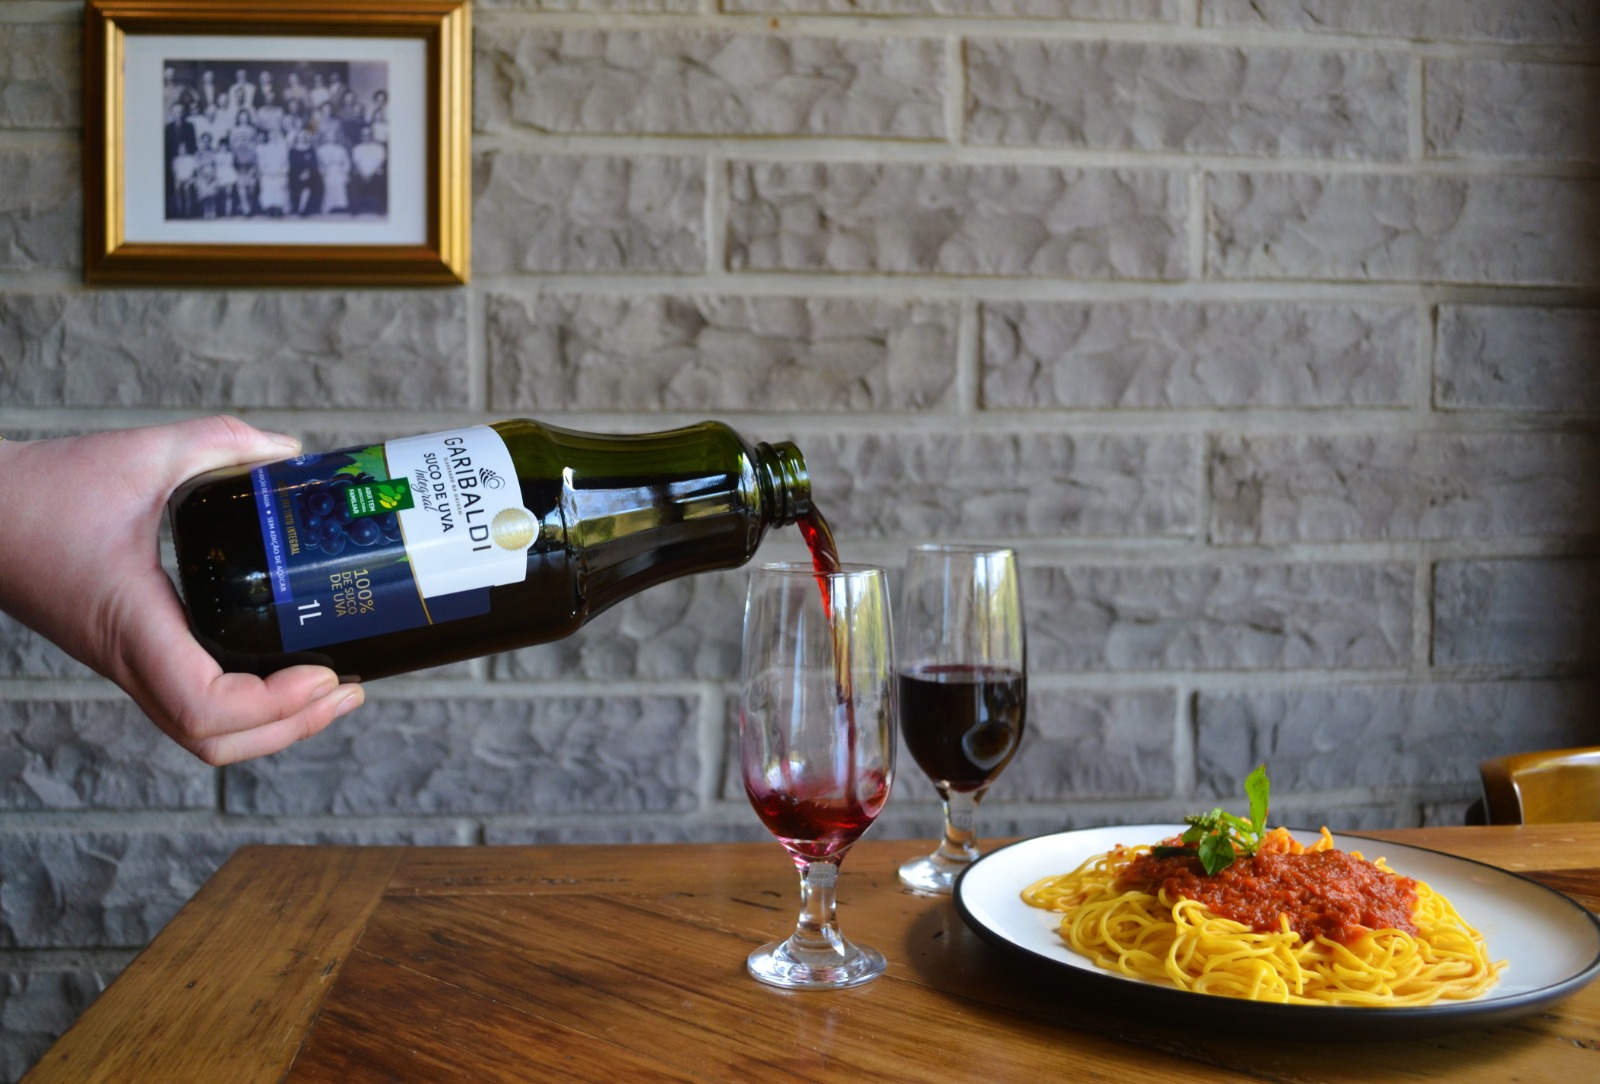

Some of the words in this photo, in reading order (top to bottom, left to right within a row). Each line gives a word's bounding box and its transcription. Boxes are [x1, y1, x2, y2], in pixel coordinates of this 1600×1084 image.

[423, 452, 442, 480] SUCO
[348, 488, 360, 514] FAMILIAR
[365, 486, 373, 499] AQUI
[410, 469, 439, 513] Integral
[433, 482, 448, 500] DE
[444, 437, 492, 552] GARIBALDI
[368, 499, 376, 512] TEM
[438, 503, 454, 533] UVA
[267, 516, 275, 530] SEM
[269, 530, 280, 555] ADIÇÃO
[287, 526, 300, 556] INTEGRAL
[274, 555, 282, 565] DE
[275, 565, 287, 593] AÇÚCAR
[329, 574, 343, 591] DE
[342, 571, 353, 585] DE
[344, 587, 358, 615] SUCO
[353, 569, 375, 614] 100%
[297, 599, 322, 626] 1L
[333, 593, 346, 618] UVA
